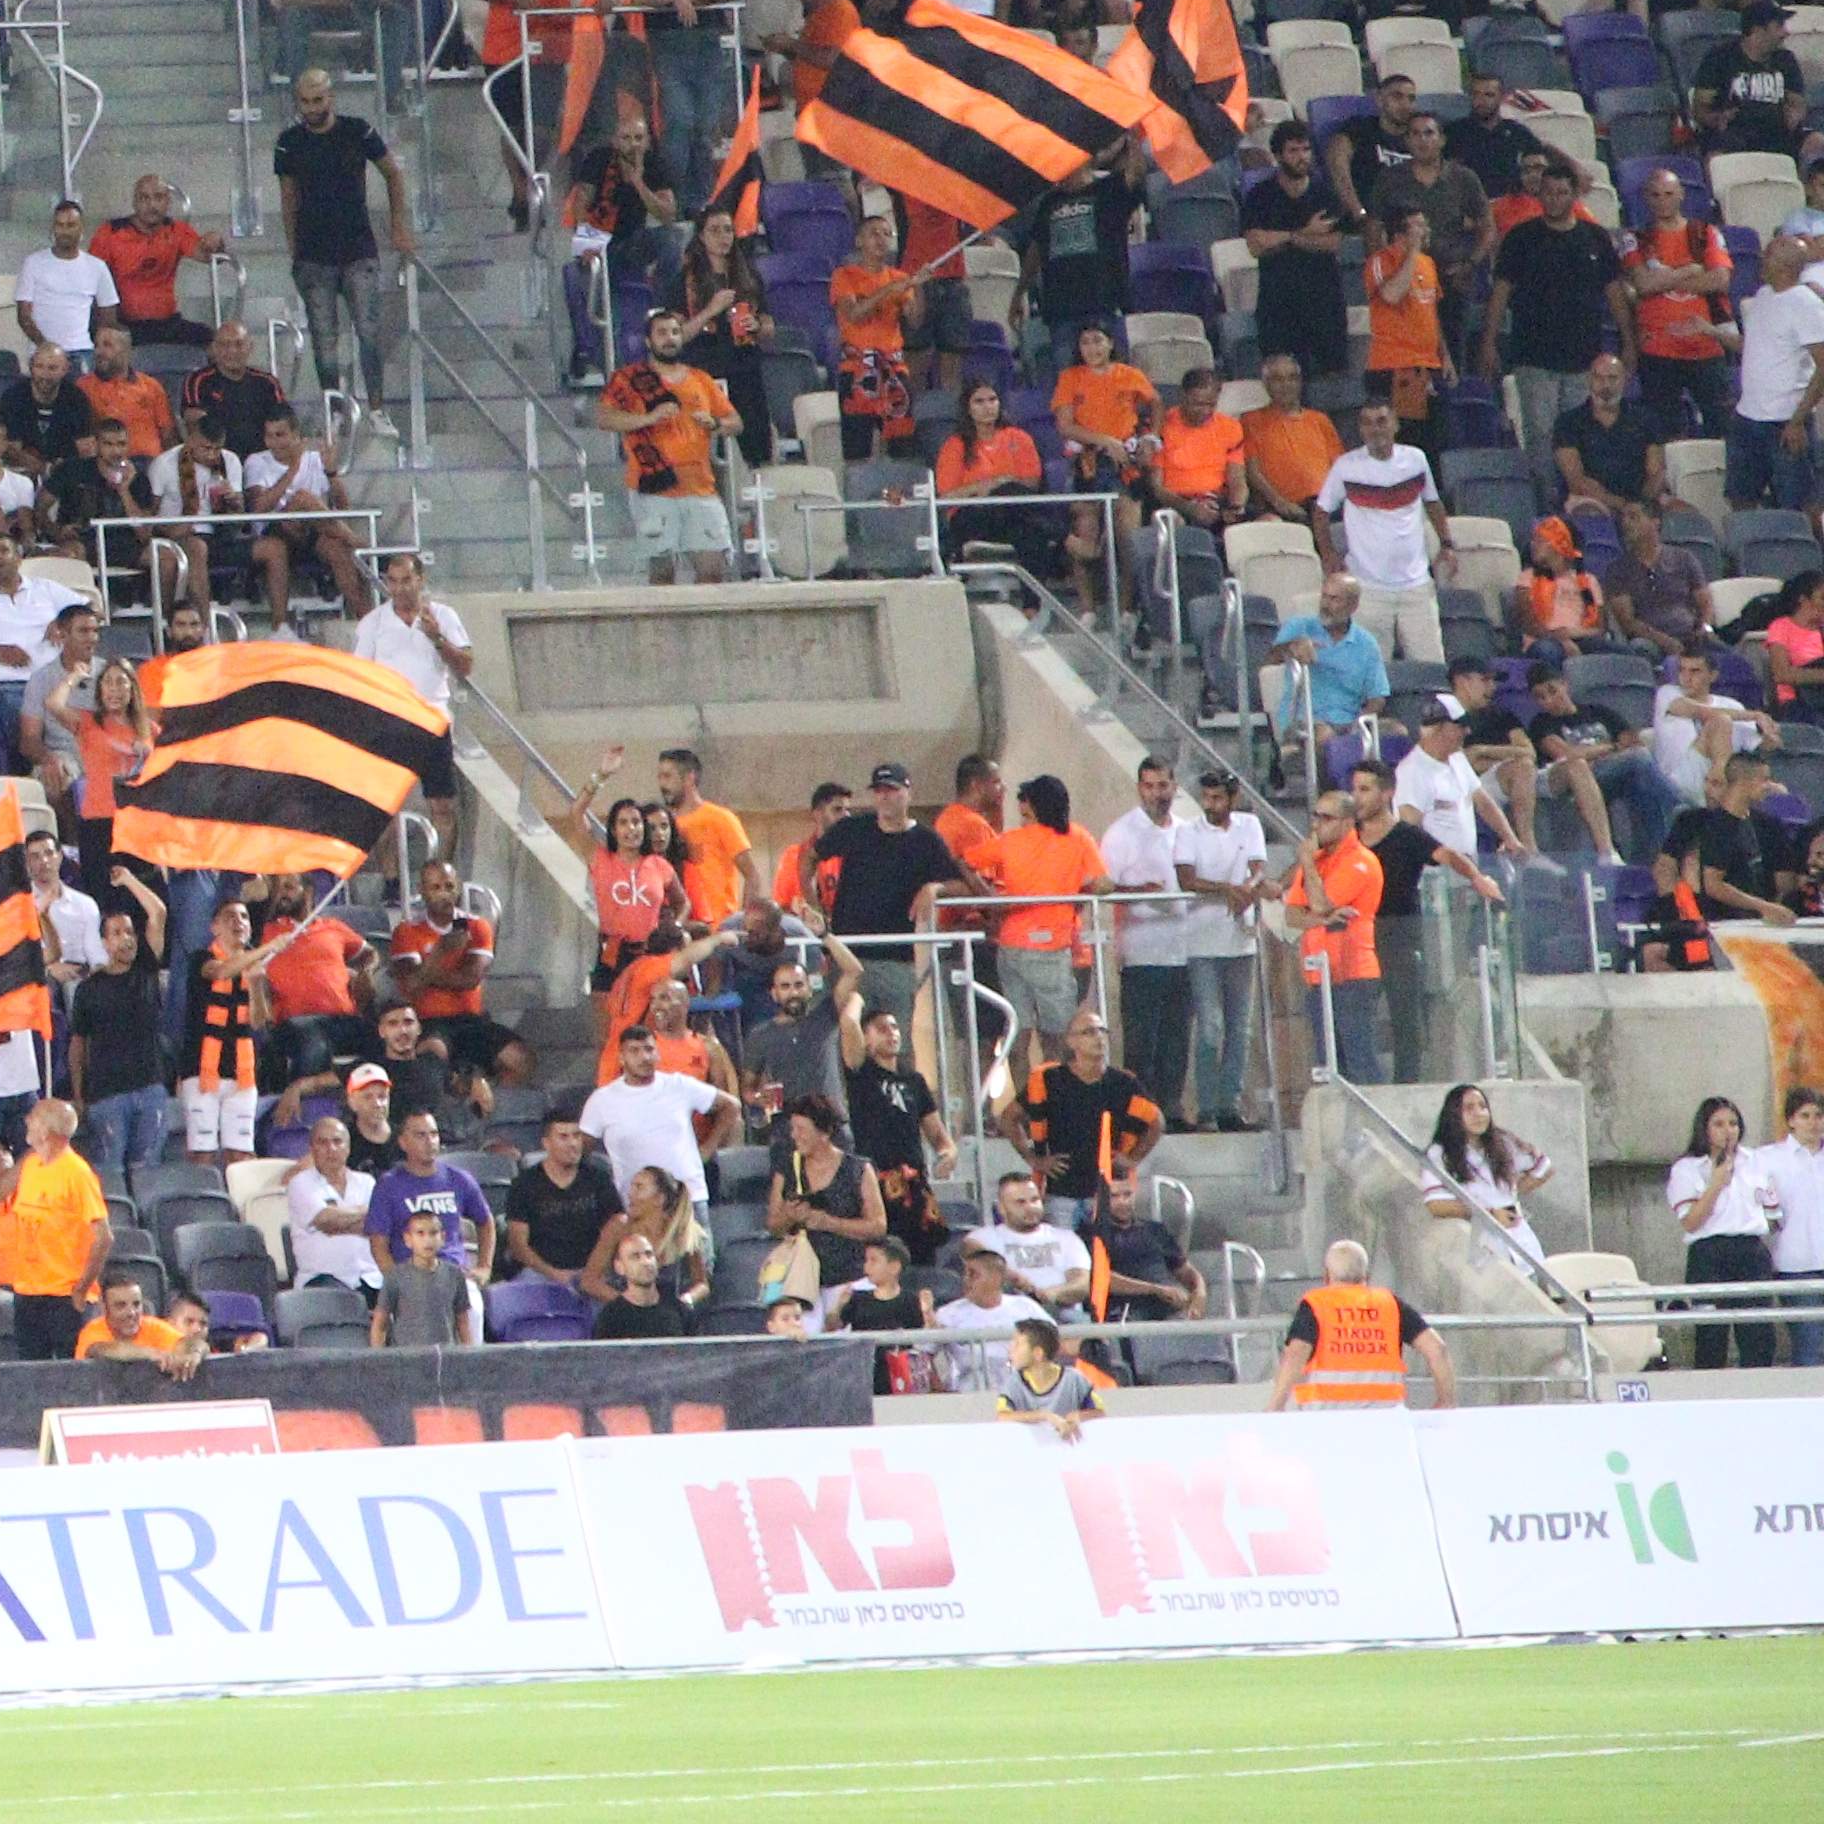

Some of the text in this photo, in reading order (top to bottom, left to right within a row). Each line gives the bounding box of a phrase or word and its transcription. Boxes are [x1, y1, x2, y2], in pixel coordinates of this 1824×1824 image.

[404, 1191, 457, 1215] VANS
[1335, 1307, 1379, 1323] סדרן
[1330, 1342, 1389, 1355] אבטחה
[1619, 1383, 1648, 1399] P10
[1488, 1510, 1610, 1543] איסתא
